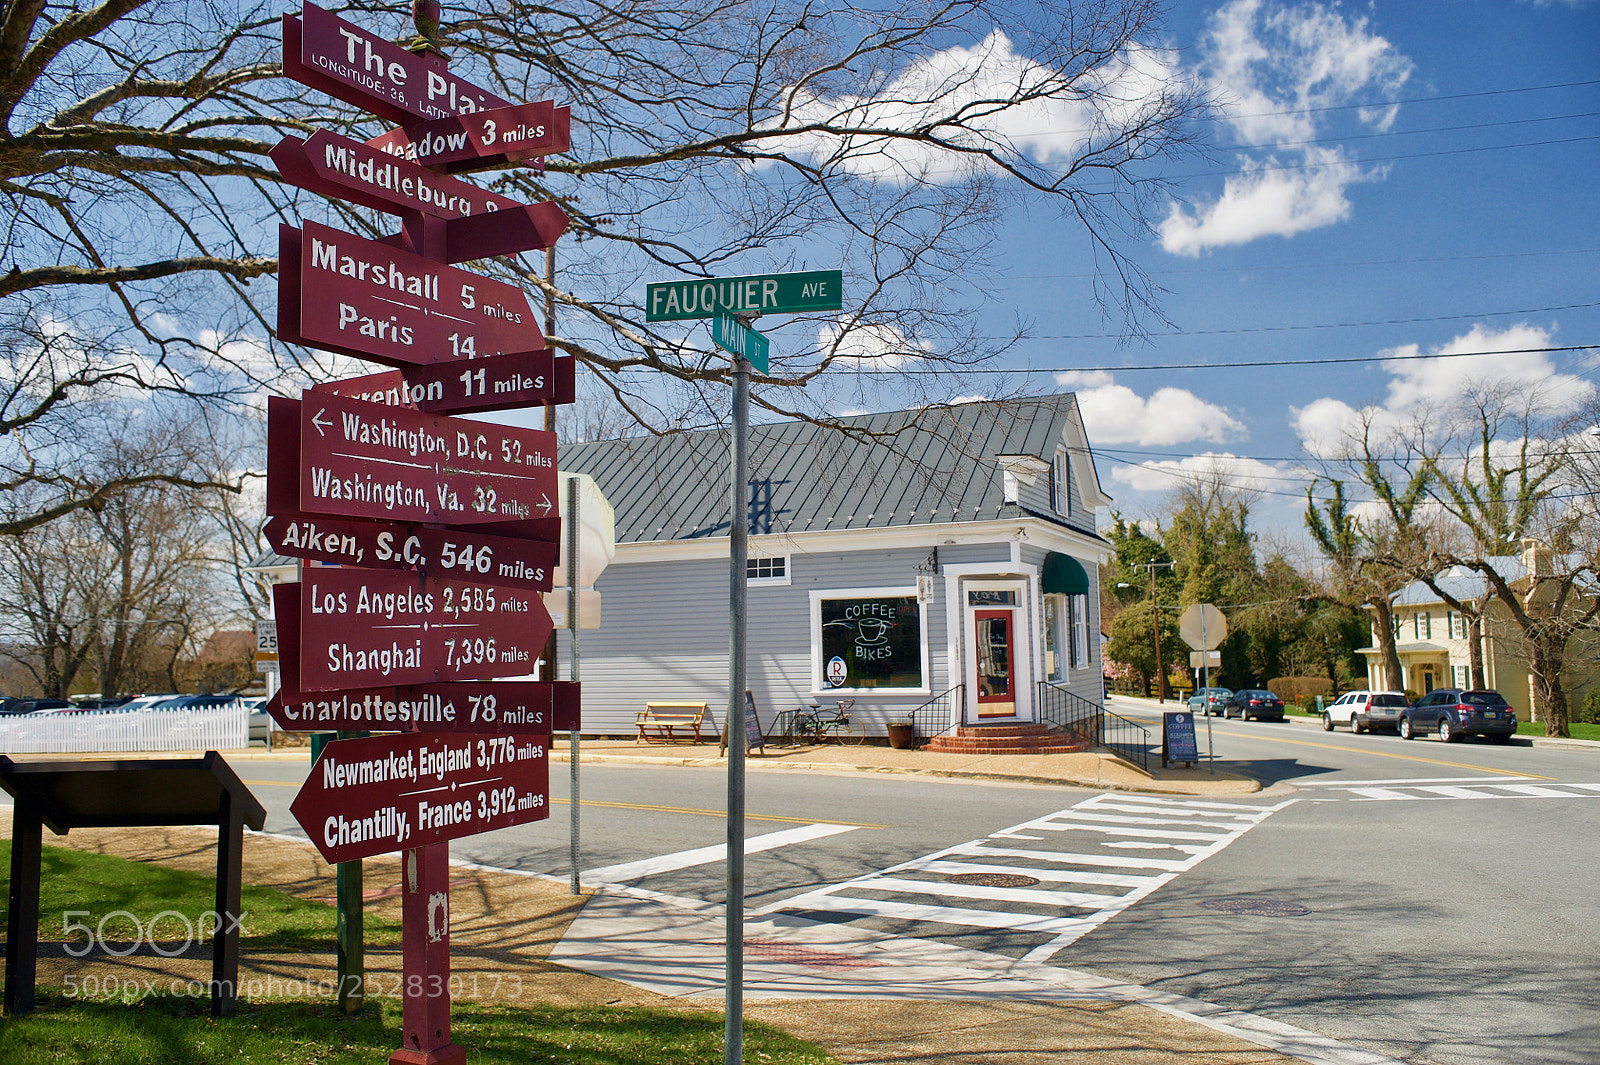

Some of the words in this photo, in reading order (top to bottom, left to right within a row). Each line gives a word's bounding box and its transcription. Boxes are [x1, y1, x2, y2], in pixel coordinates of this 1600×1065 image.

[311, 53, 385, 94] LONGITUDE:
[390, 88, 409, 107] 38,
[419, 101, 450, 119] LATIT
[340, 26, 408, 86] The
[427, 70, 491, 115] Plai
[481, 119, 497, 146] 3
[503, 123, 545, 143] miles
[325, 143, 471, 217] Middleburg
[311, 237, 439, 302] Marshall
[460, 284, 475, 311] 5
[482, 303, 521, 325] miles
[652, 279, 778, 315] FAUQUIER
[801, 282, 827, 298] AVE
[338, 301, 414, 347] Paris
[448, 332, 476, 360] 14
[721, 312, 746, 356] MAIN
[459, 368, 486, 397] 11
[494, 373, 545, 394] miles
[341, 411, 451, 460] Washington,
[457, 431, 492, 461] D.C.
[501, 438, 522, 464] 52
[526, 451, 552, 468] miles
[311, 466, 430, 514] Washington,
[437, 482, 464, 511] Va.
[473, 486, 497, 513] 32
[501, 501, 530, 520] miles
[282, 522, 364, 563] Aiken,
[375, 531, 427, 566] S.C.
[440, 541, 494, 574] 546
[499, 560, 545, 582] miles
[311, 584, 347, 615] Los
[356, 585, 434, 619] Angeles
[443, 586, 496, 619] 2,585
[500, 597, 528, 613] miles
[845, 603, 896, 619] COFFEE
[259, 636, 277, 648] 25
[328, 640, 421, 676] Shanghai
[444, 639, 497, 672] 7,396
[501, 647, 530, 664] miles
[855, 646, 892, 660] BIKES
[833, 662, 841, 675] R
[468, 694, 497, 723] 78
[503, 707, 543, 724] miles
[323, 750, 417, 789] Newmarket,
[419, 742, 471, 780] England
[477, 736, 515, 773] 3,776
[517, 743, 543, 760] miles
[323, 806, 411, 848] Chantilly,
[418, 798, 472, 830] France
[477, 786, 516, 823] 3,912
[518, 792, 543, 811] miles
